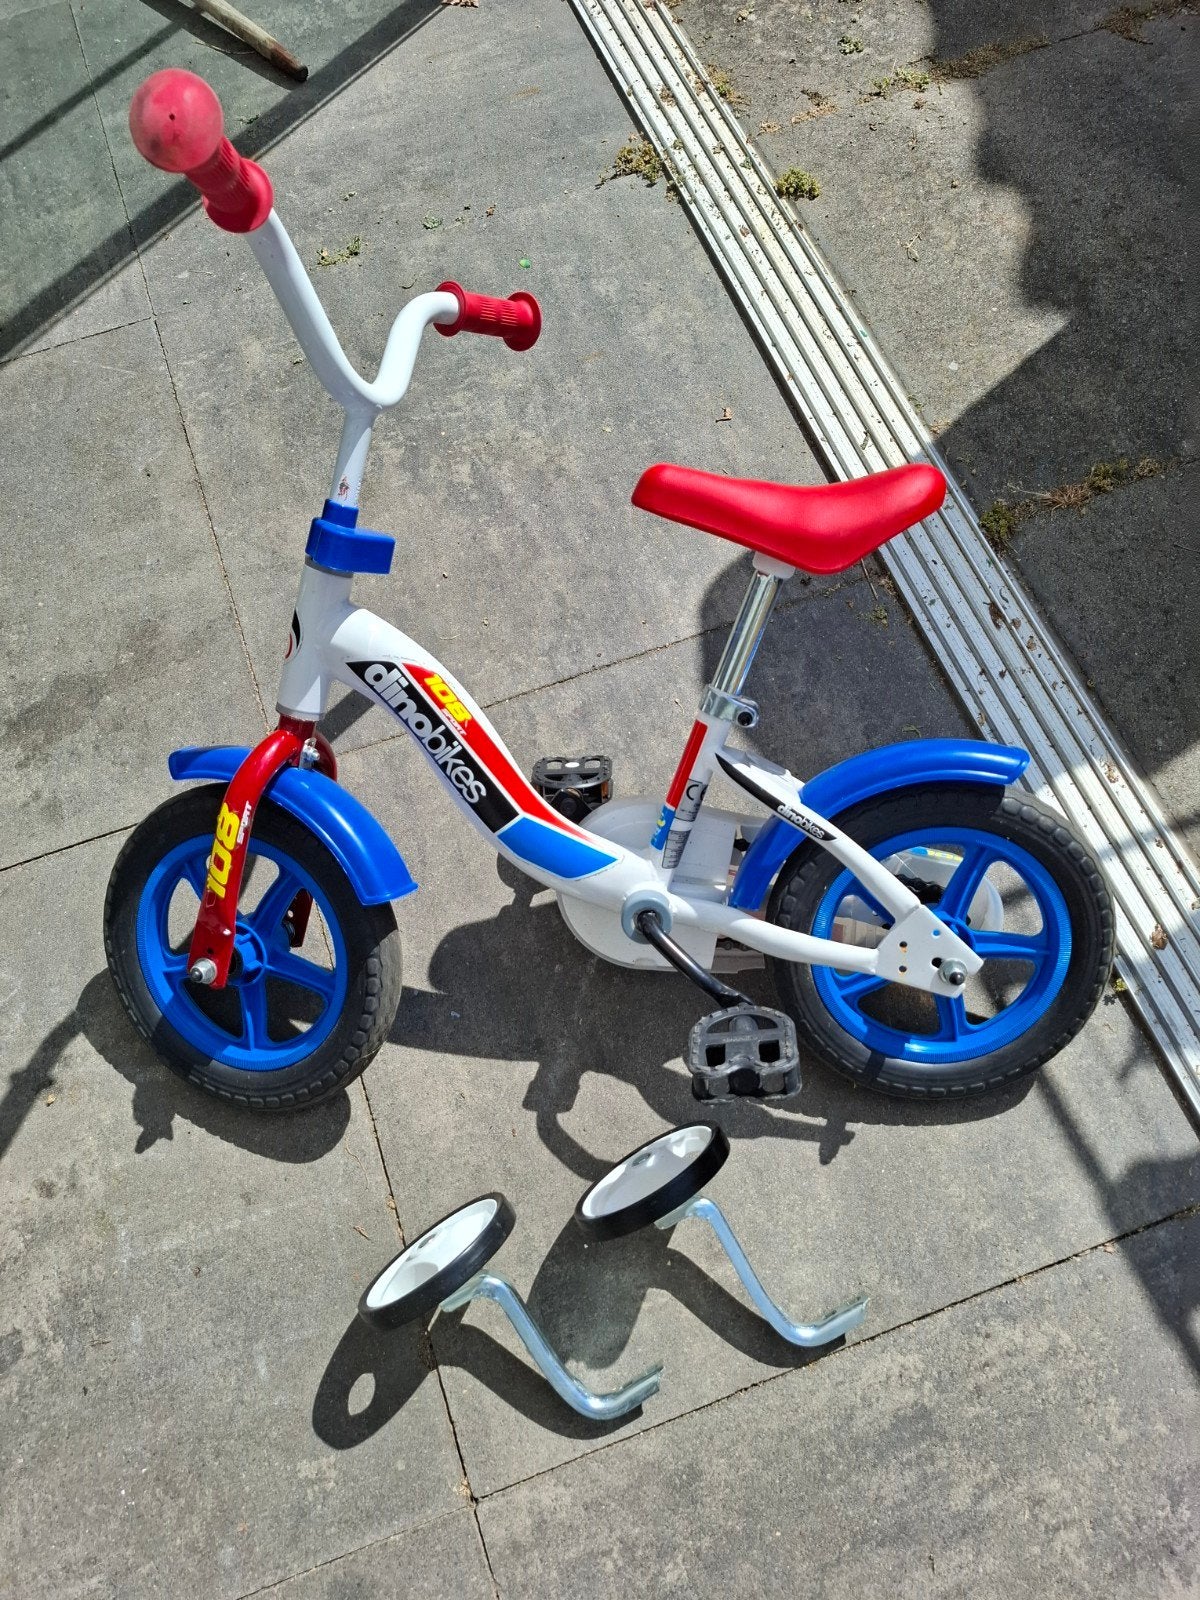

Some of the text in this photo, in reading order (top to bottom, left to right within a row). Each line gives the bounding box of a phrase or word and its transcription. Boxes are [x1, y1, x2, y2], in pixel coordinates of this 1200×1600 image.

[363, 663, 487, 804] dinobikes
[424, 673, 472, 724] 108
[206, 802, 240, 898] 108
[777, 804, 826, 839] dinobikes
